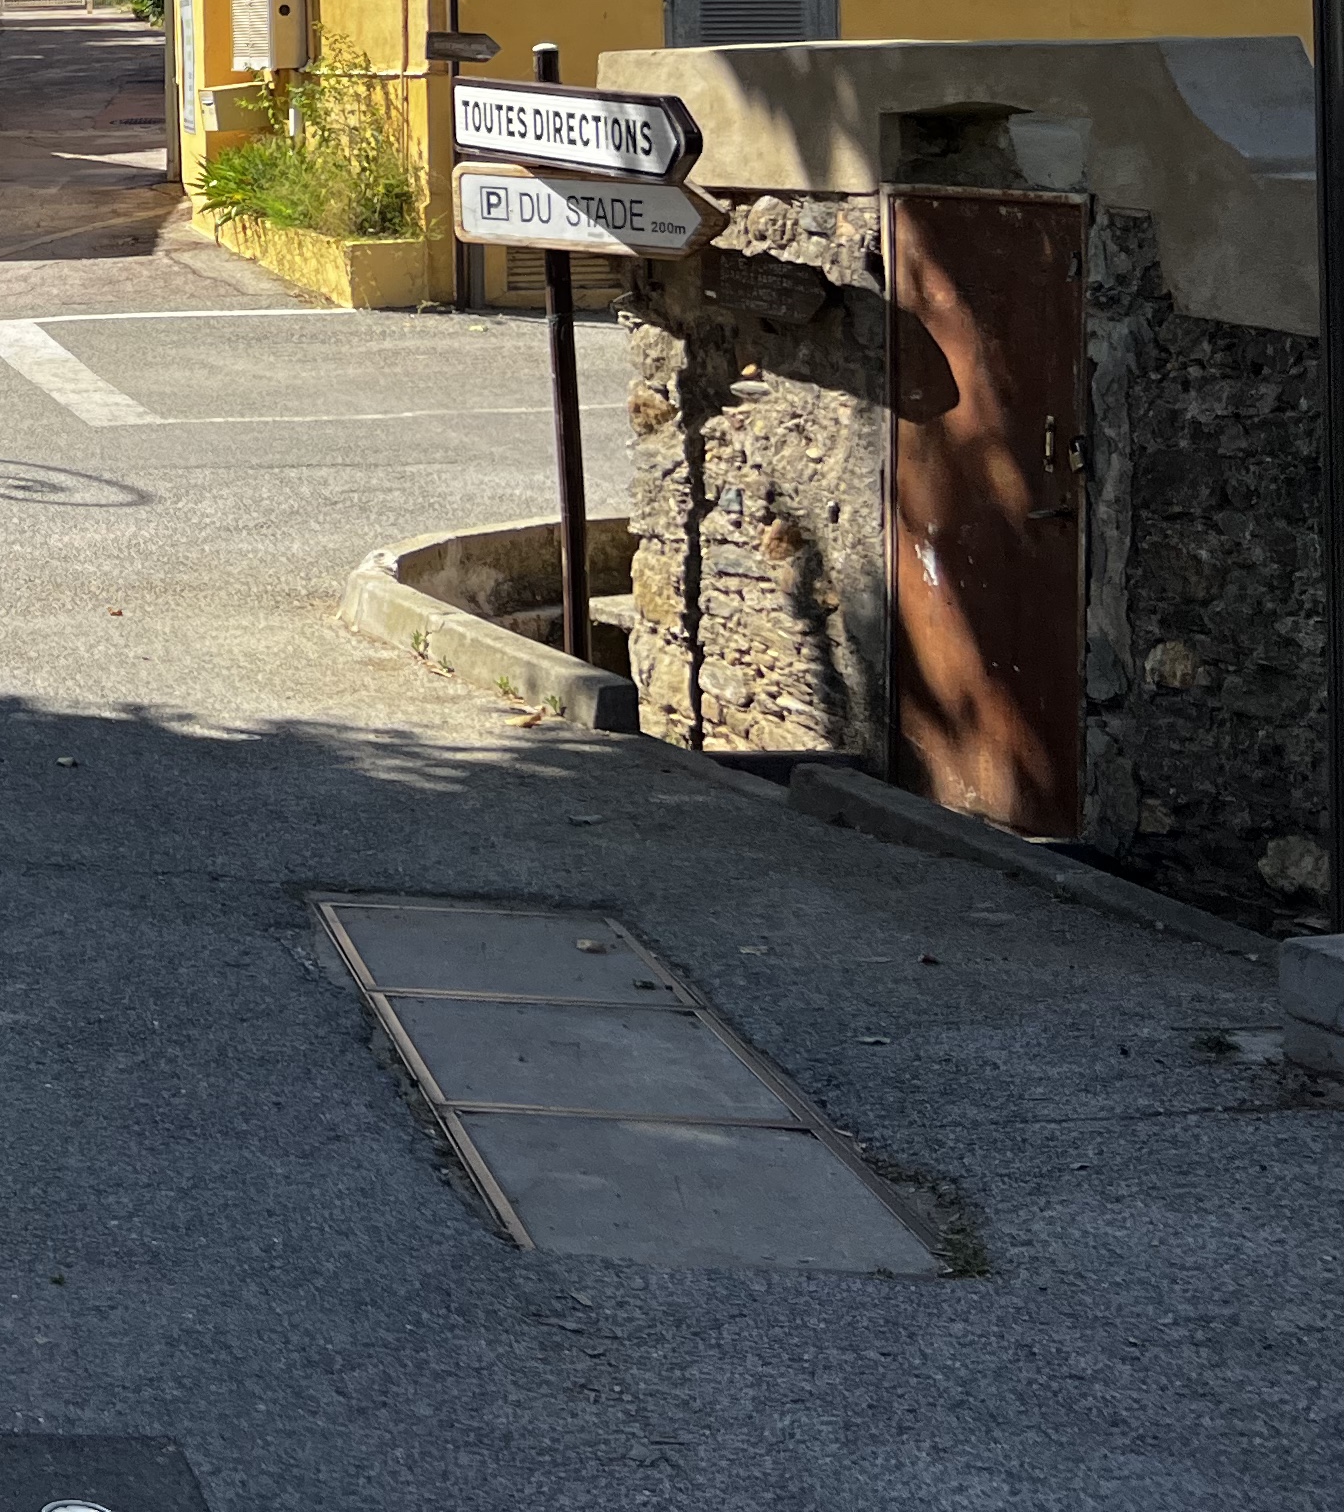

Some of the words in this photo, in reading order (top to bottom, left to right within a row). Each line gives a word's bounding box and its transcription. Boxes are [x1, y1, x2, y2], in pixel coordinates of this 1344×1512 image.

[462, 100, 528, 139] TOUTES
[532, 108, 652, 156] DIRECTIONS
[519, 192, 552, 224] DU
[565, 195, 645, 231] STADE
[650, 221, 687, 236] 200m
